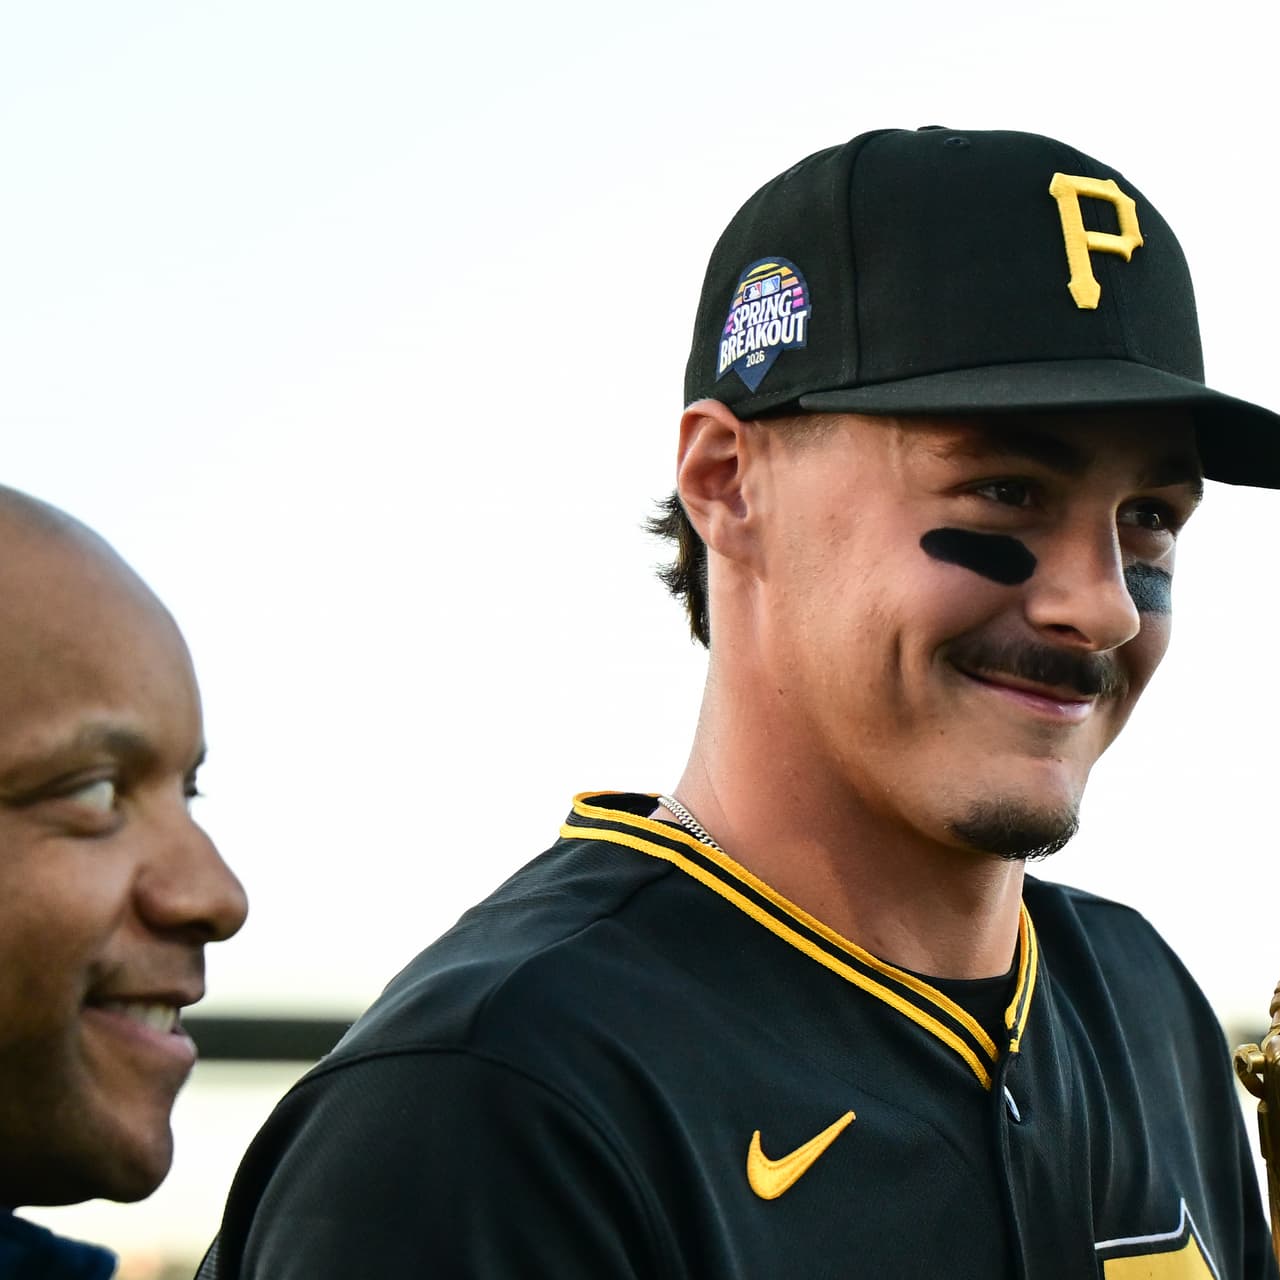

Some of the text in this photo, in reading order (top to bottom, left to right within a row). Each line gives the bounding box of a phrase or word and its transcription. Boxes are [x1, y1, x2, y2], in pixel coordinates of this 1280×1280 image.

[1048, 171, 1144, 310] P
[731, 289, 793, 335] SPRING
[719, 310, 808, 374] BREAKOUT
[745, 350, 766, 368] 2026
